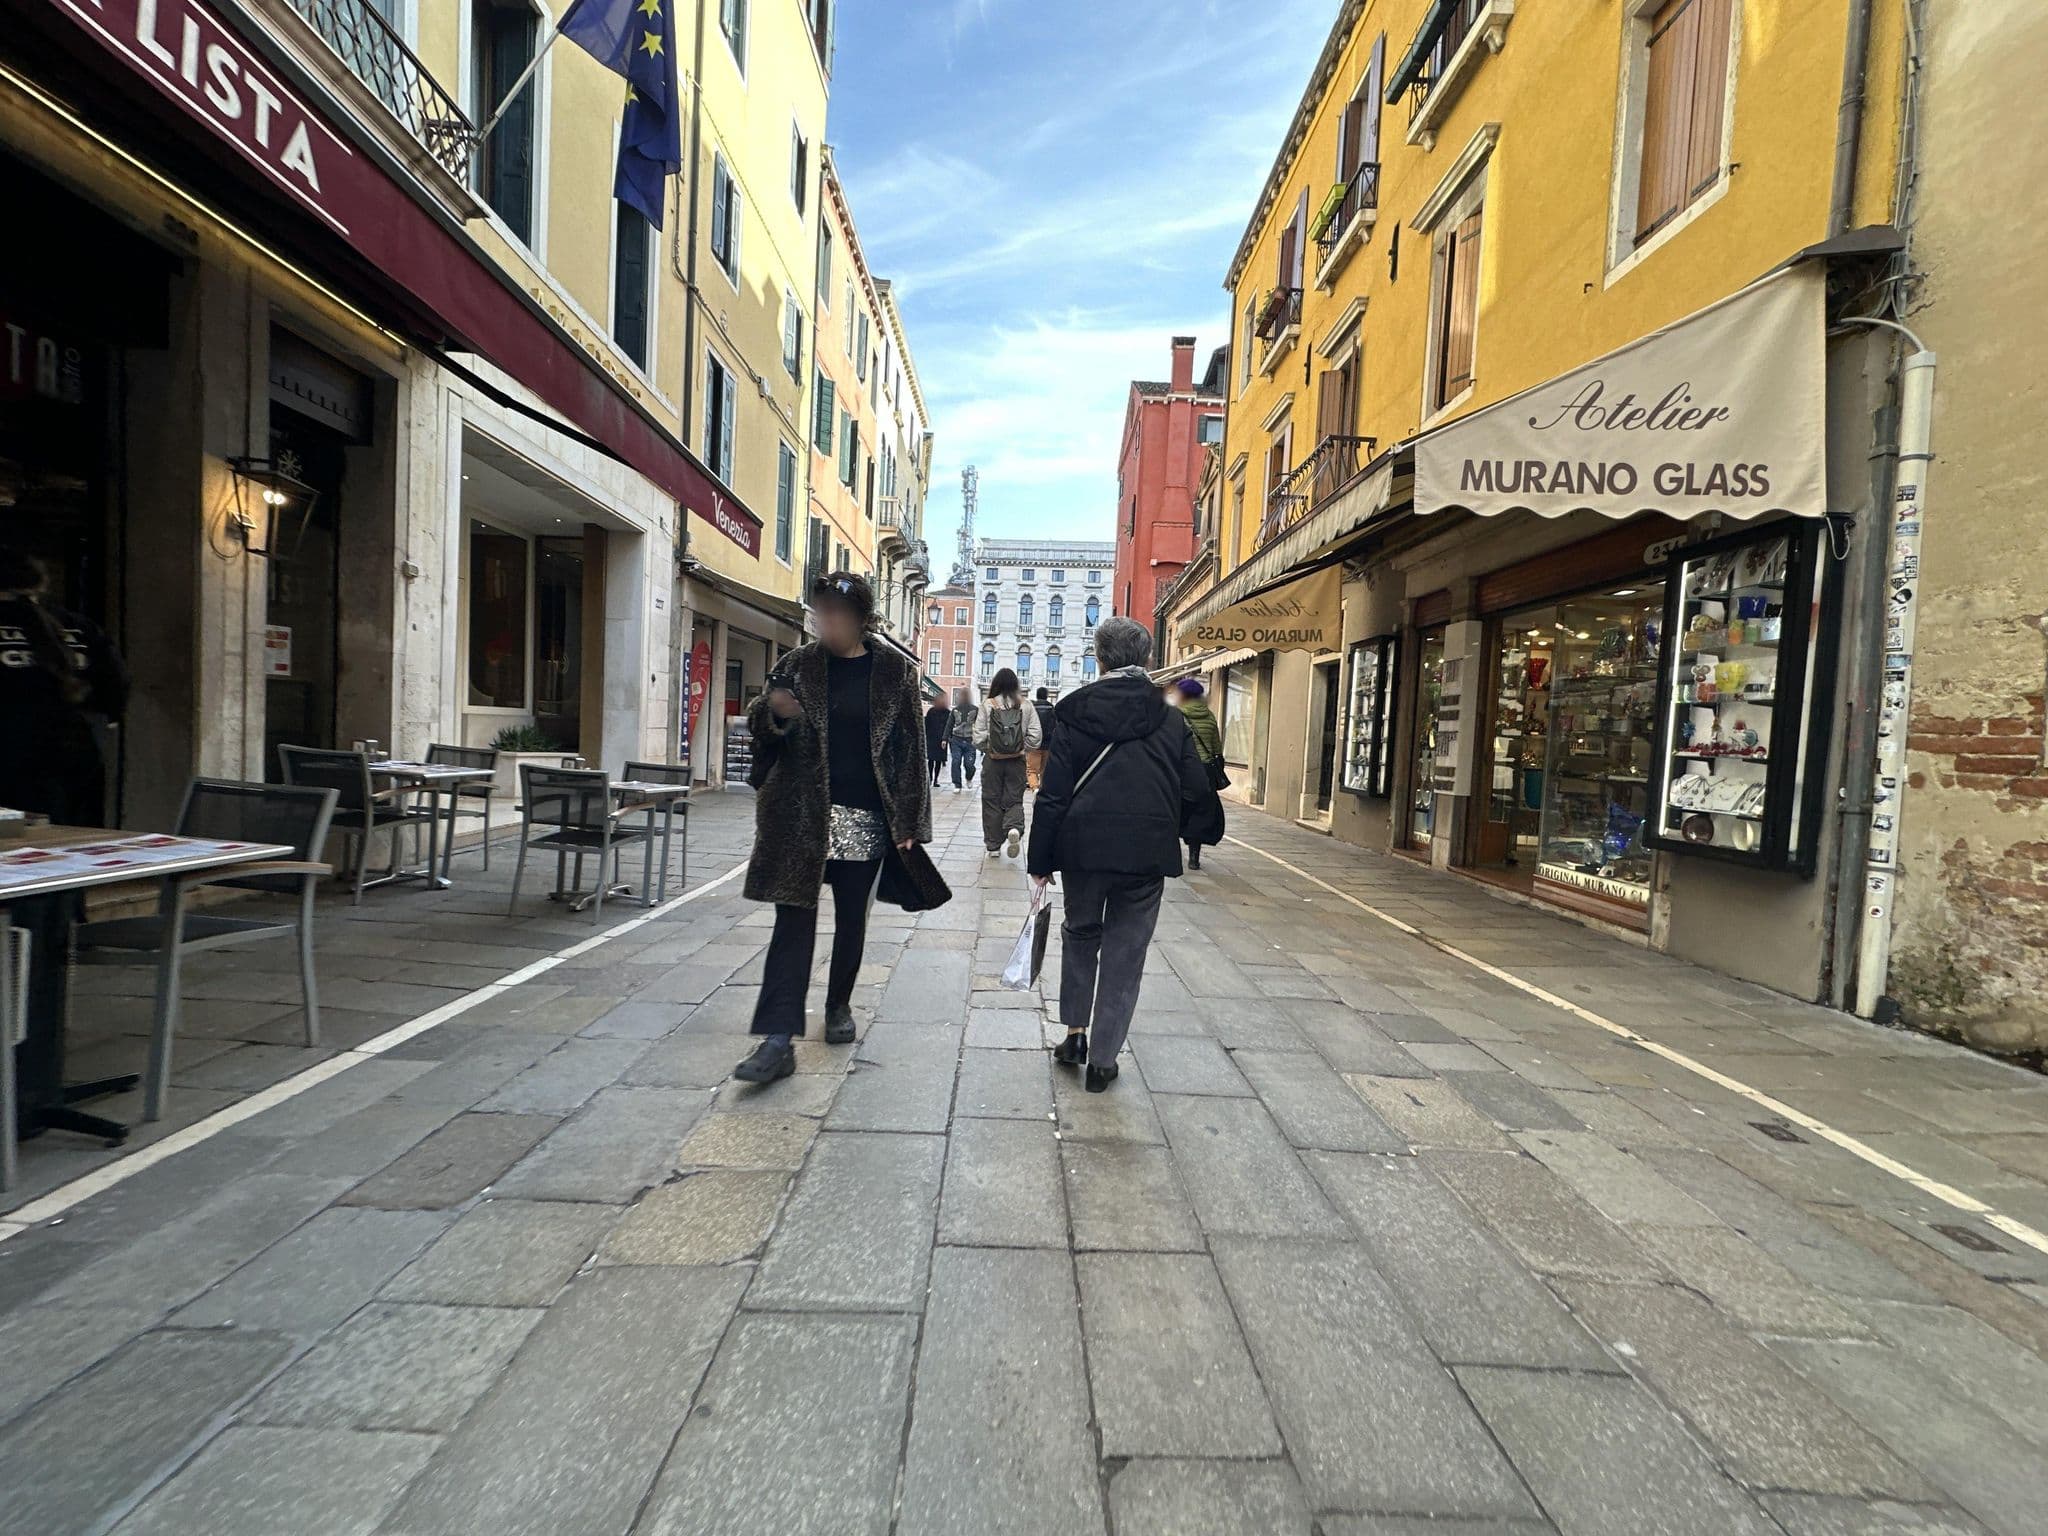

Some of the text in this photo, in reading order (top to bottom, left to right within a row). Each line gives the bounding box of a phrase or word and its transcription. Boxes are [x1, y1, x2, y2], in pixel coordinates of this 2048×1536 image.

[136, 0, 321, 194] LISTA
[1528, 379, 1730, 431] Atelier
[1460, 459, 1771, 498] MURANO GLASS
[712, 491, 751, 549] Venezia
[1539, 867, 1581, 886] ORIGINAL
[1583, 877, 1626, 898] MURANO
